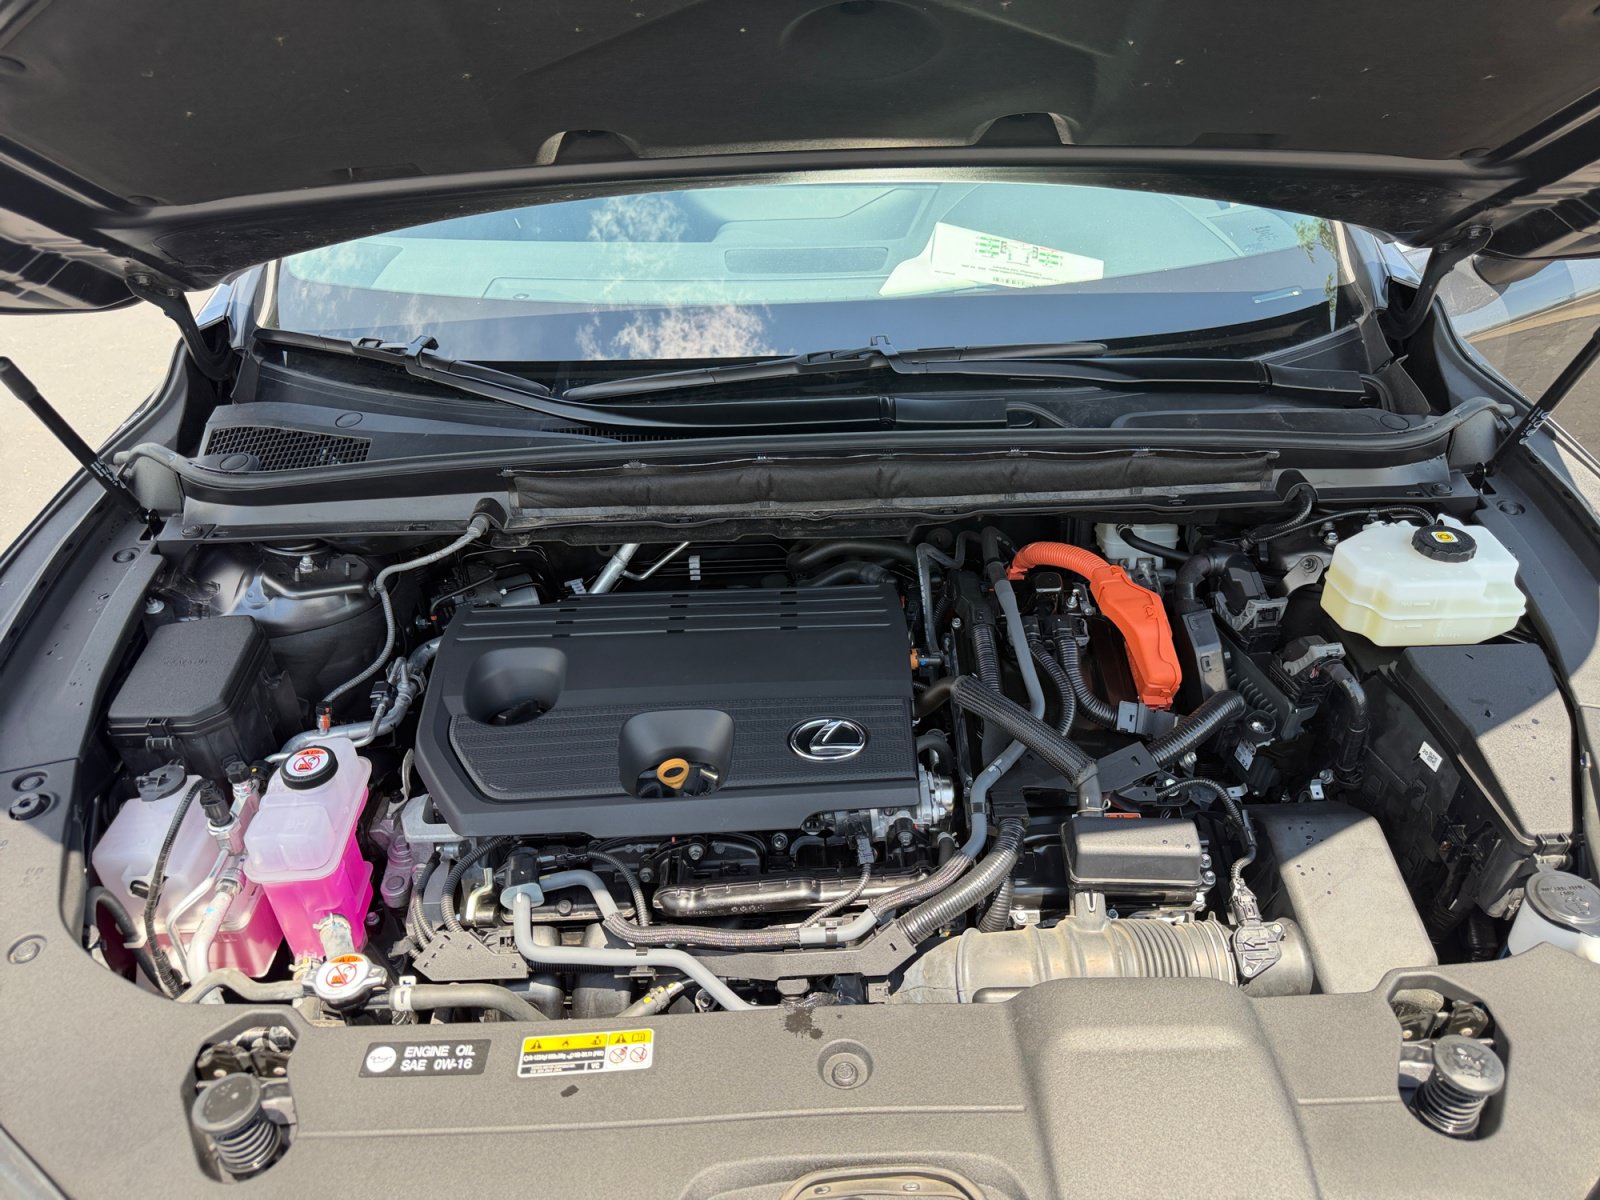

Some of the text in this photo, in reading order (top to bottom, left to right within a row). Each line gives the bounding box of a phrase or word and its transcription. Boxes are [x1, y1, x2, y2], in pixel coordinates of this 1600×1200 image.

[404, 1044, 476, 1058] ENGINE OIL
[400, 1058, 473, 1072] SAE 0W-16
